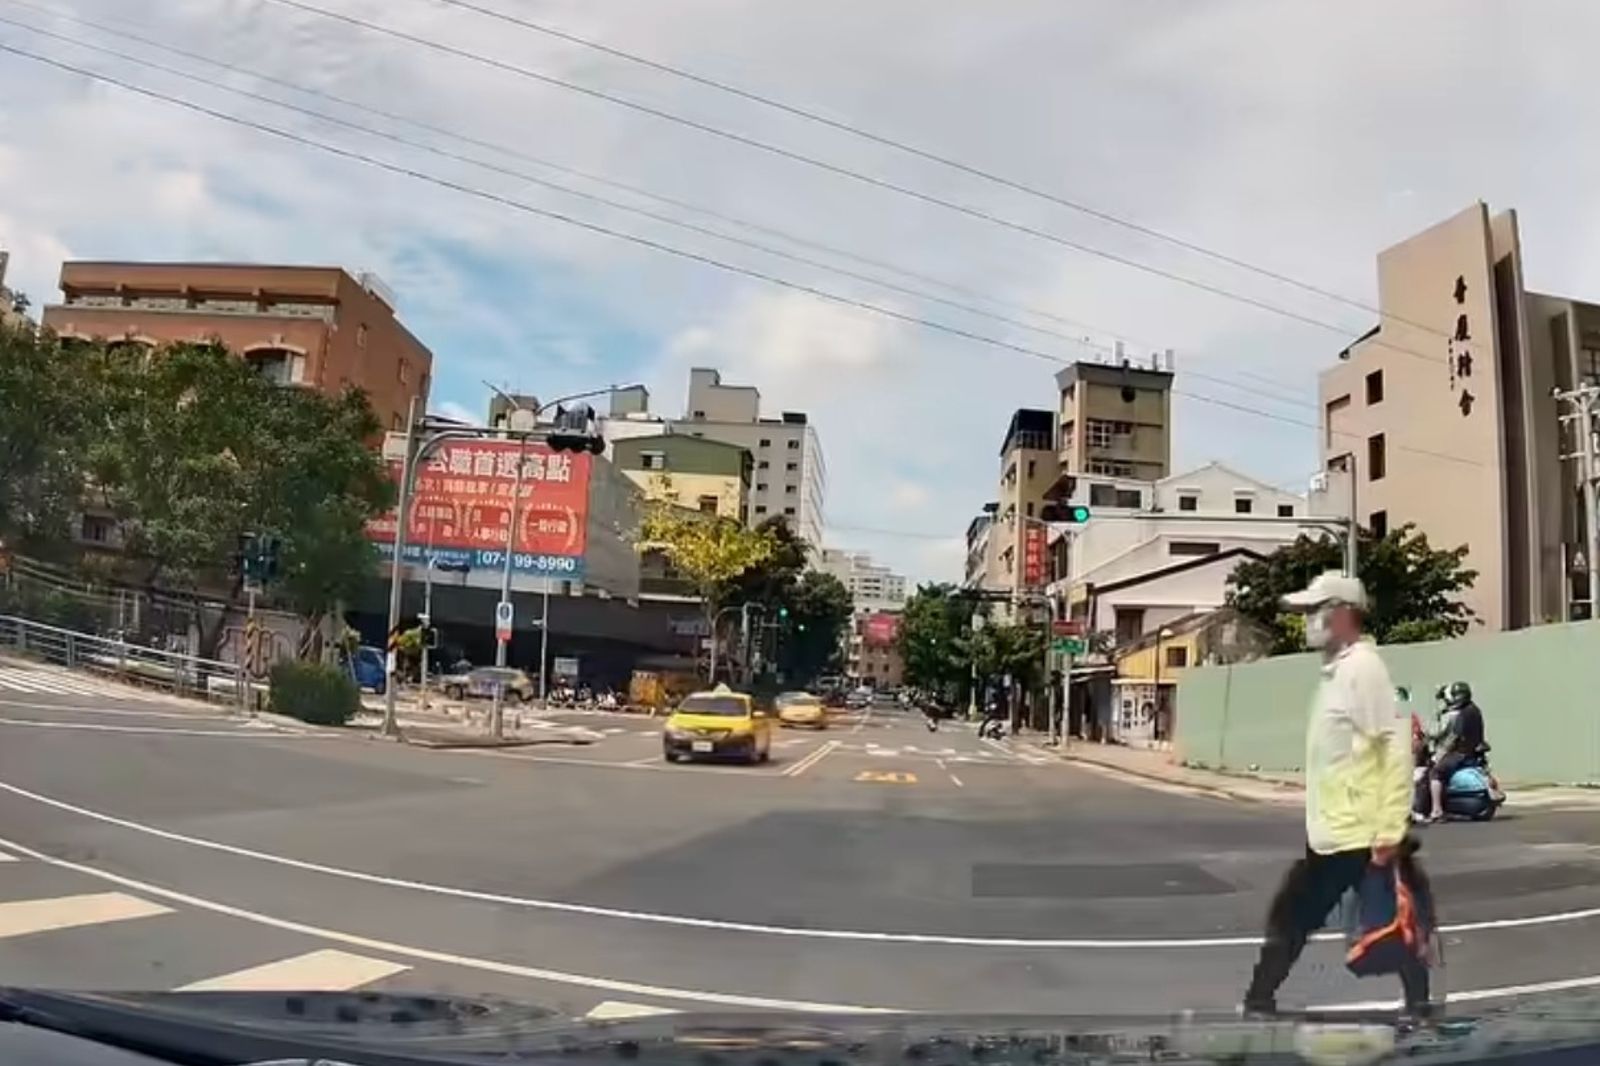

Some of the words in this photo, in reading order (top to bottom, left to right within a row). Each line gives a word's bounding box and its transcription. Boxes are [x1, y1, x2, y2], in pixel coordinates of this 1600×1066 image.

[427, 447, 571, 482] 公職首選高點
[482, 551, 575, 571] 07-99-8990
